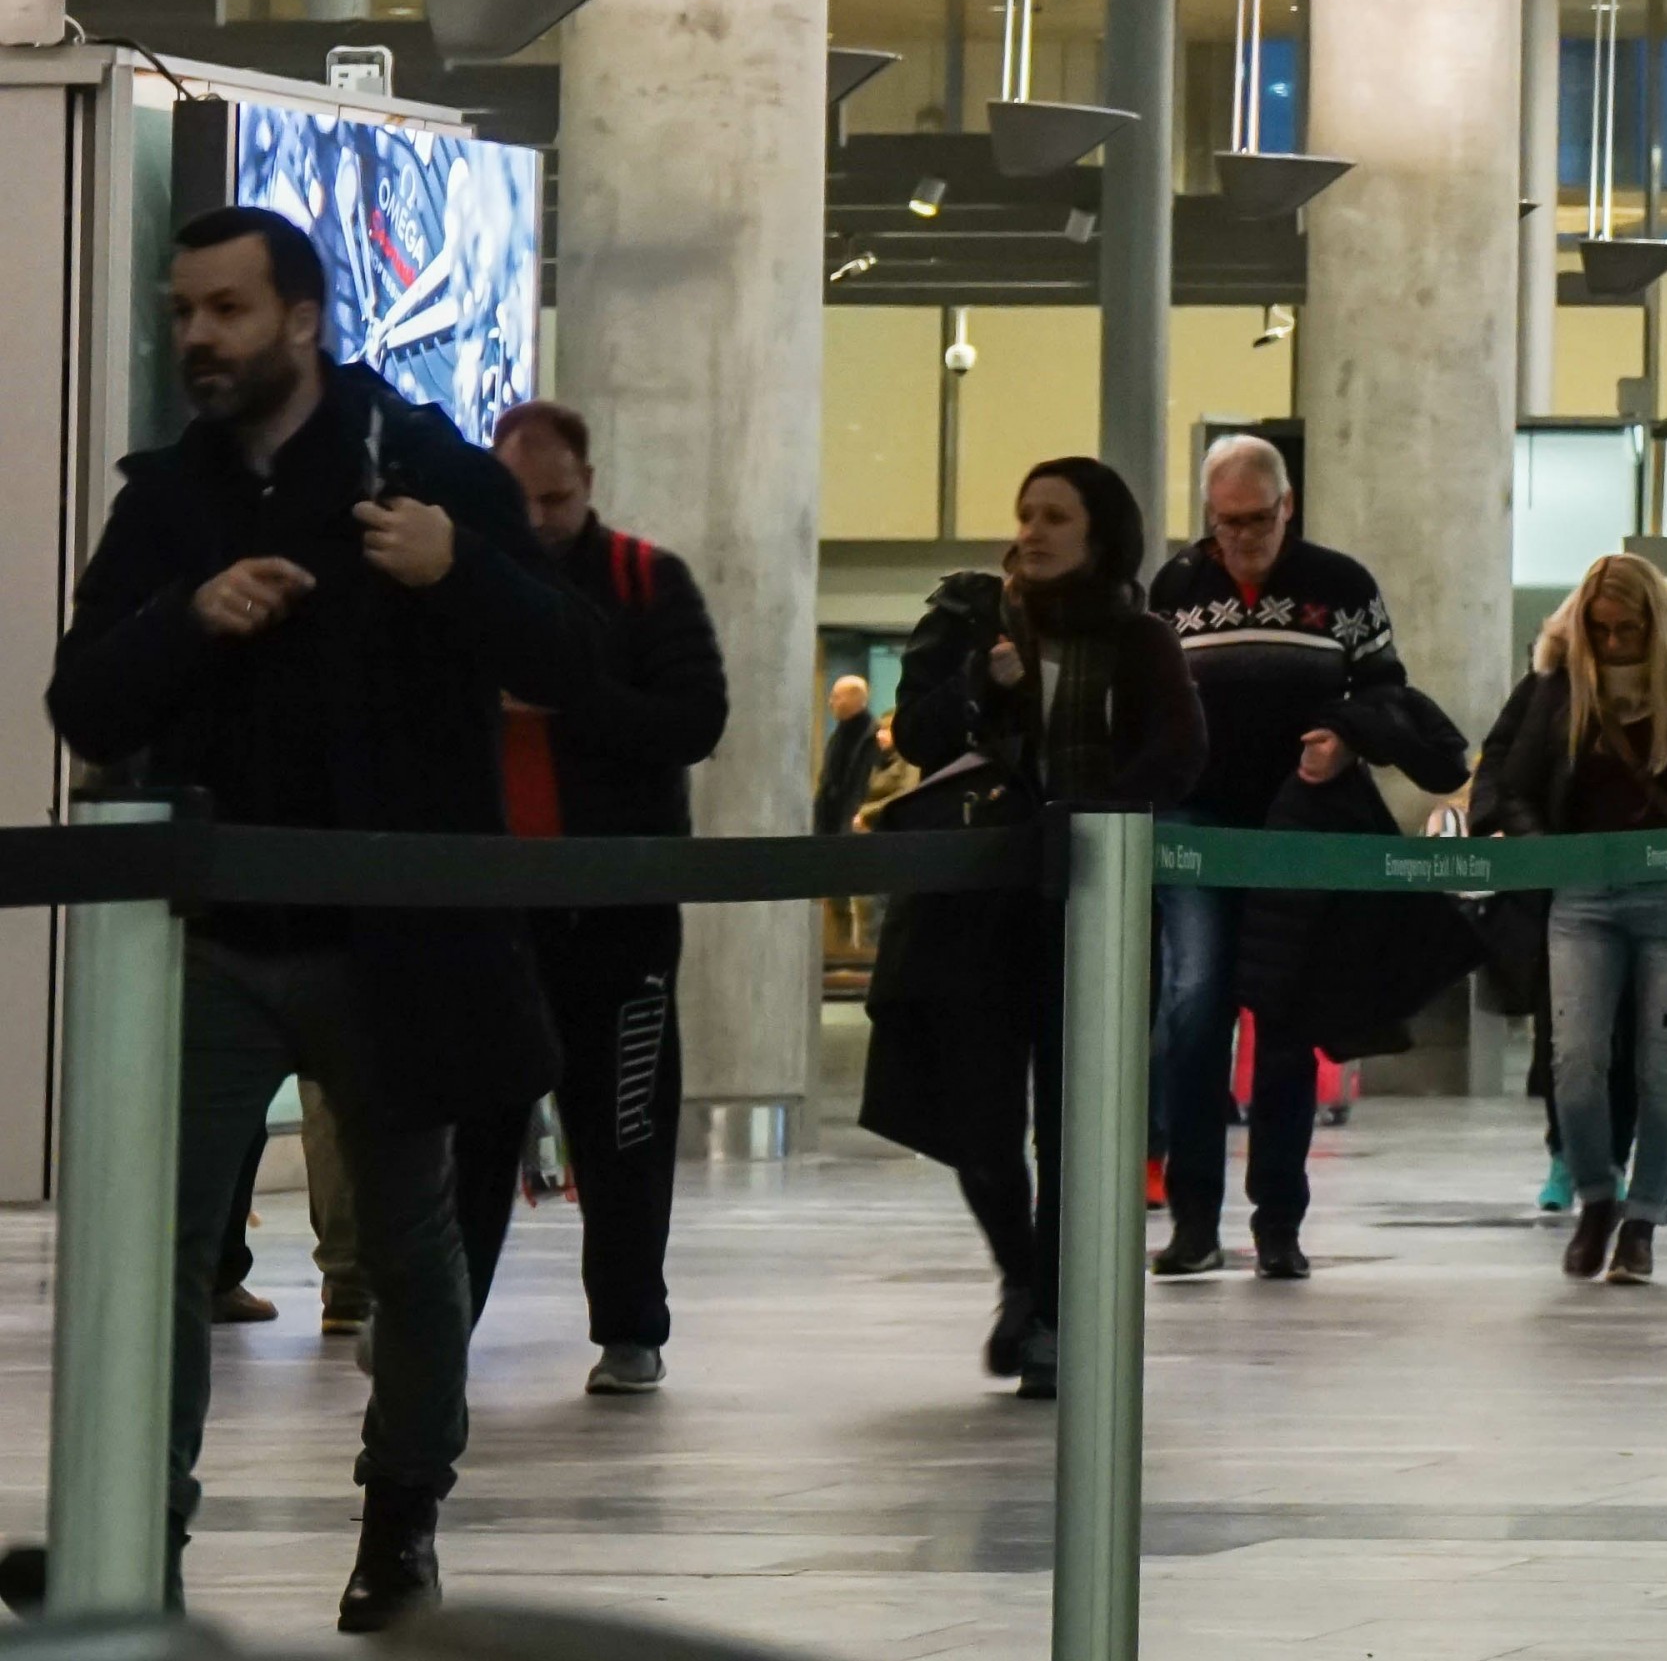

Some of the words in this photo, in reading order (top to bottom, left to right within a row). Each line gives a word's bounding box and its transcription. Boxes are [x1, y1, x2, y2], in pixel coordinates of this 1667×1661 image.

[379, 178, 426, 270] OMEGA
[1161, 844, 1175, 869] No
[1177, 844, 1202, 878] Entry
